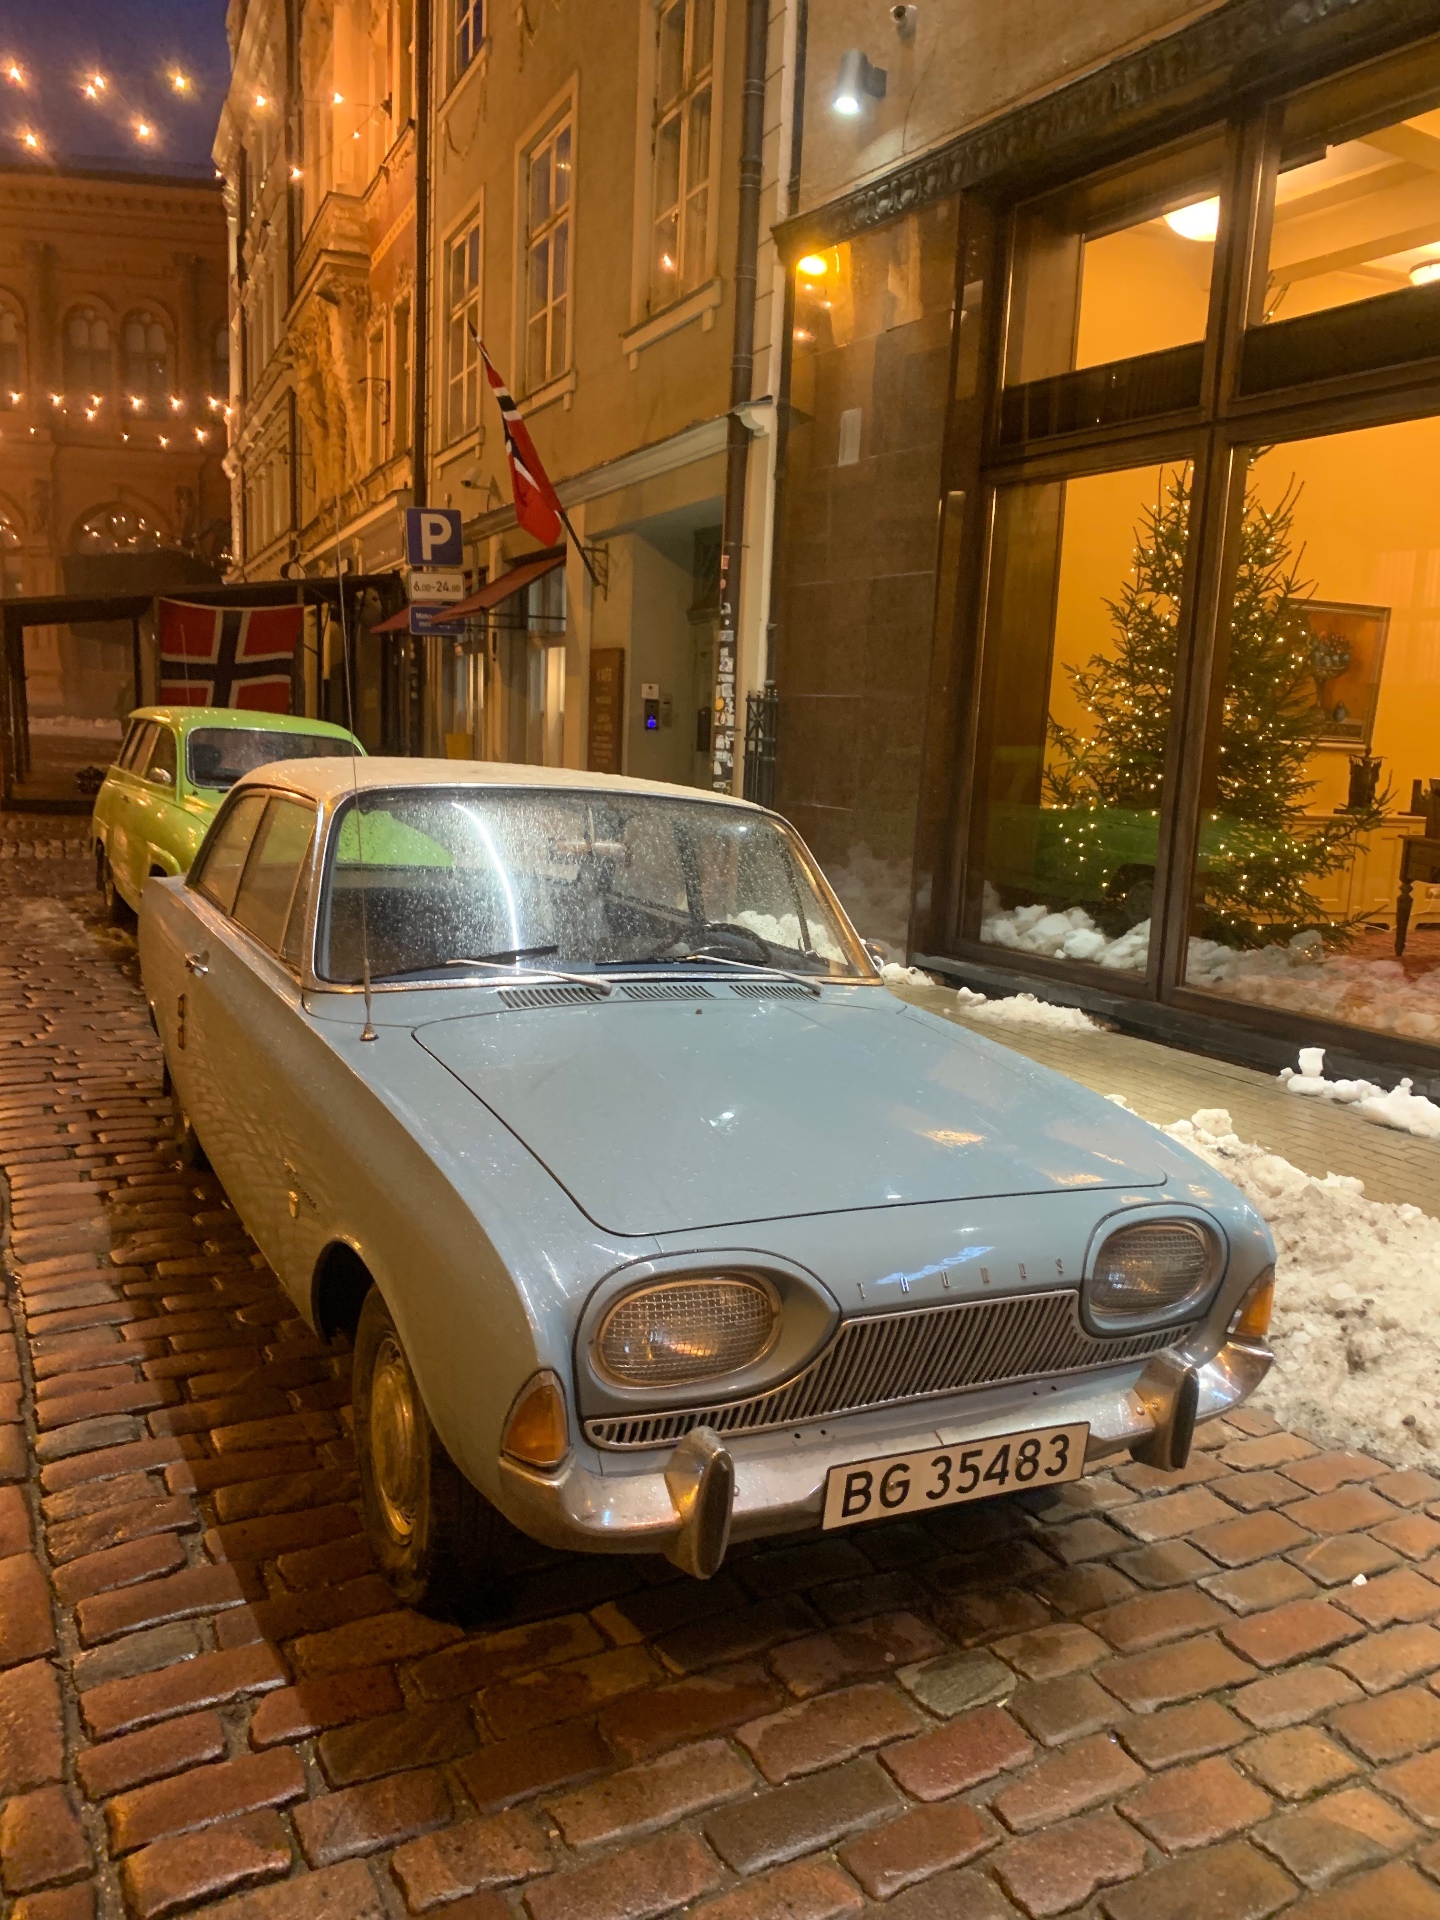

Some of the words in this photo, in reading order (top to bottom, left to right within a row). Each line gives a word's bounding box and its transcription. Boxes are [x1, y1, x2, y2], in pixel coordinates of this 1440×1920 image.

[420, 513, 452, 561] P
[841, 1463, 911, 1518] BG
[926, 1433, 1070, 1501] 35483
